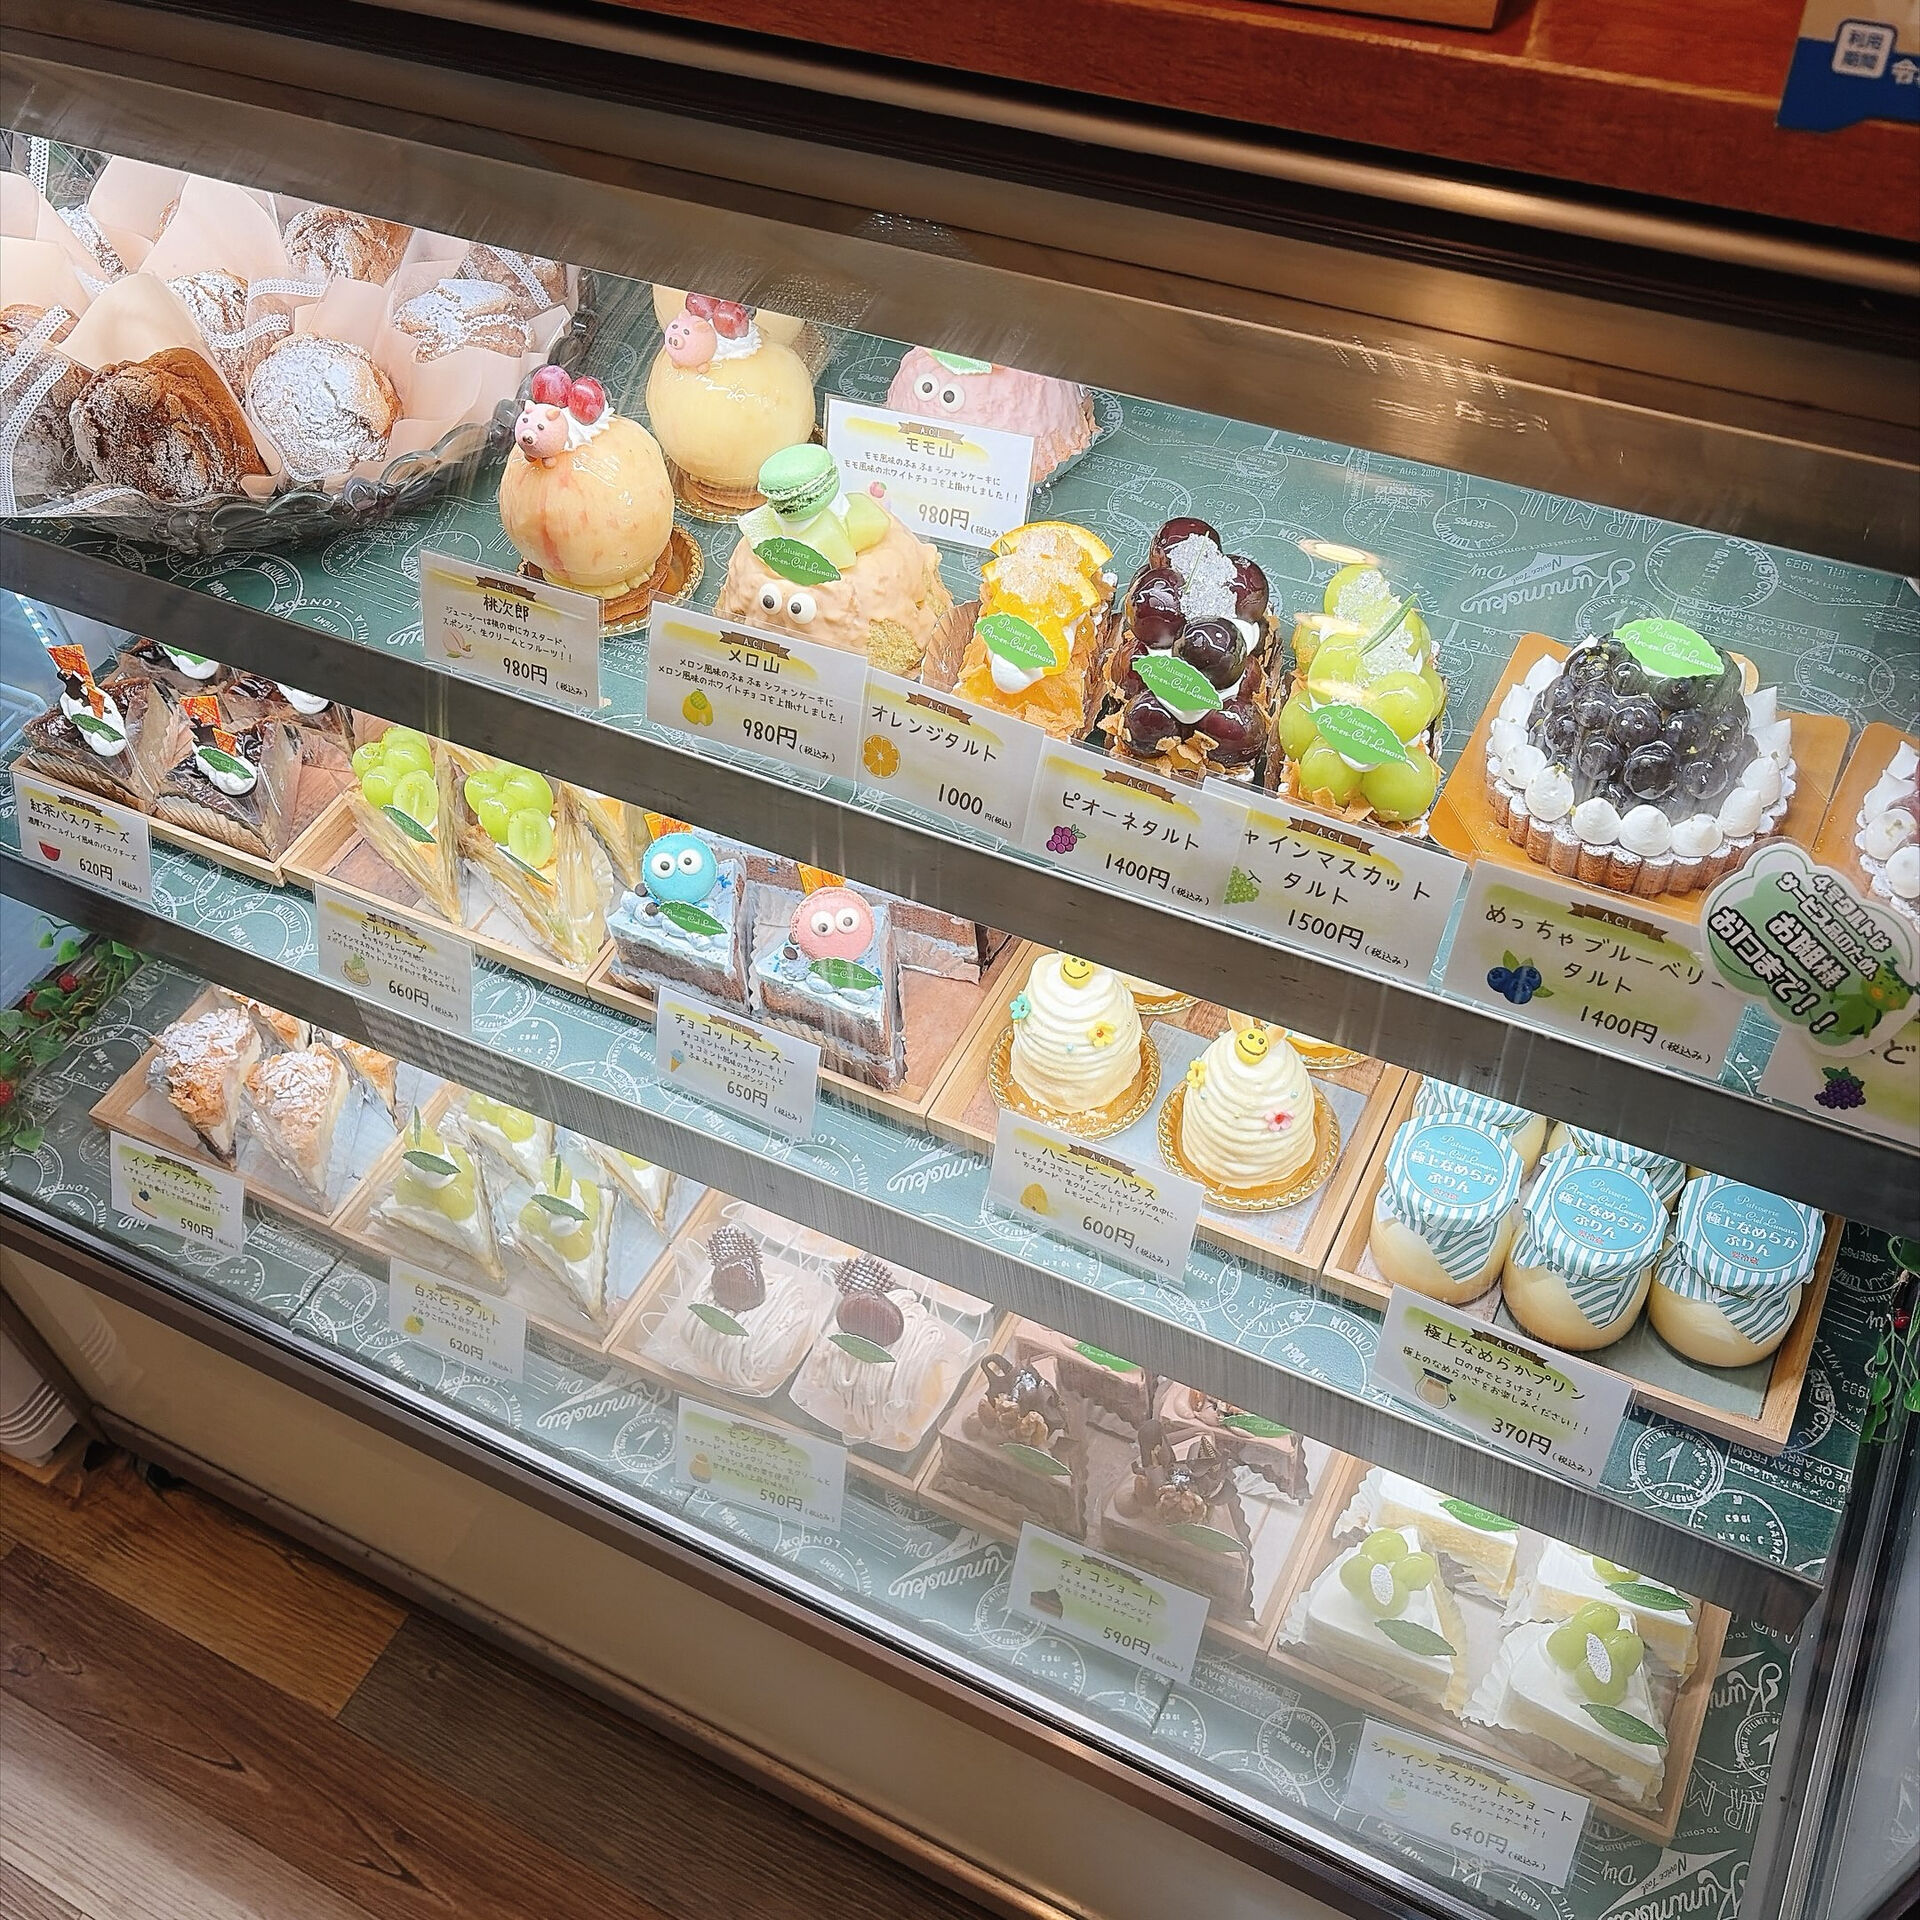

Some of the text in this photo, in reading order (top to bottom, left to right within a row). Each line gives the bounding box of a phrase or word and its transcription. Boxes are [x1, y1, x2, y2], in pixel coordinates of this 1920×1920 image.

[906, 437, 955, 459] モモ山
[918, 503, 970, 531] 980円
[1519, 490, 1600, 530] MAIL
[483, 593, 530, 623] 桃次郎
[1675, 605, 1711, 622] FROM
[1712, 614, 1743, 629] STAY
[997, 617, 1031, 641] Patisserie
[503, 657, 548, 686] 980円
[728, 649, 780, 674] メロ山
[1157, 658, 1194, 681] Patisserie
[871, 705, 997, 762] オレンジタルト
[1337, 707, 1378, 734] Patisserie
[743, 718, 836, 763] 980円 （税込み）
[938, 783, 983, 815] 1000
[29, 798, 130, 844] 紅茶バスクチーズ
[1062, 791, 1200, 851] ピオーネタルト
[1316, 827, 1345, 844] A.C.L
[79, 858, 113, 881] 620円
[1105, 853, 1210, 906] 1400円 （税込み）
[1243, 829, 1431, 901] ャインマスカット
[1283, 872, 1349, 905] タルト
[1601, 912, 1634, 929] A.C.L
[1776, 871, 1880, 982] サービス品のため、
[1813, 874, 1893, 952] 4号タルトは
[360, 920, 427, 954] ミルクレープ
[1287, 909, 1410, 968] 1500円 （税込み）
[388, 980, 429, 1008] 660円
[1563, 962, 1632, 994] タルト
[674, 1013, 795, 1065] チョコットスースー
[1579, 1005, 1712, 1064] 1400円 （税込み）
[727, 1080, 769, 1109] 650円
[132, 1156, 223, 1195] インディアンサマー
[1042, 1148, 1156, 1200] ハニービーハウス
[1410, 1150, 1498, 1186] 極上なめらか
[1558, 1190, 1646, 1234] 極上なめらか
[1735, 1195, 1780, 1217] Patisserie
[180, 1218, 214, 1240] 590円
[1082, 1215, 1136, 1249] 600円
[1705, 1210, 1798, 1249] 極上なめらか
[415, 1284, 501, 1327] 白ぶどうタルト
[449, 1338, 484, 1361] 620円
[1423, 1322, 1585, 1400] 極上なめらかプリン
[1402, 1346, 1590, 1435] 極上のなめらかさをお楽しみください！！
[1454, 1357, 1541, 1401] 口の中でとろける！
[727, 1427, 791, 1454] モンブラン
[1491, 1417, 1593, 1477] 370円 （税込み）
[759, 1489, 803, 1512] 590円
[1060, 1559, 1159, 1607] チョコショート
[1103, 1626, 1150, 1656] 590円
[1371, 1740, 1573, 1823] シャインマスカットショート
[1450, 1821, 1508, 1854] 640円
